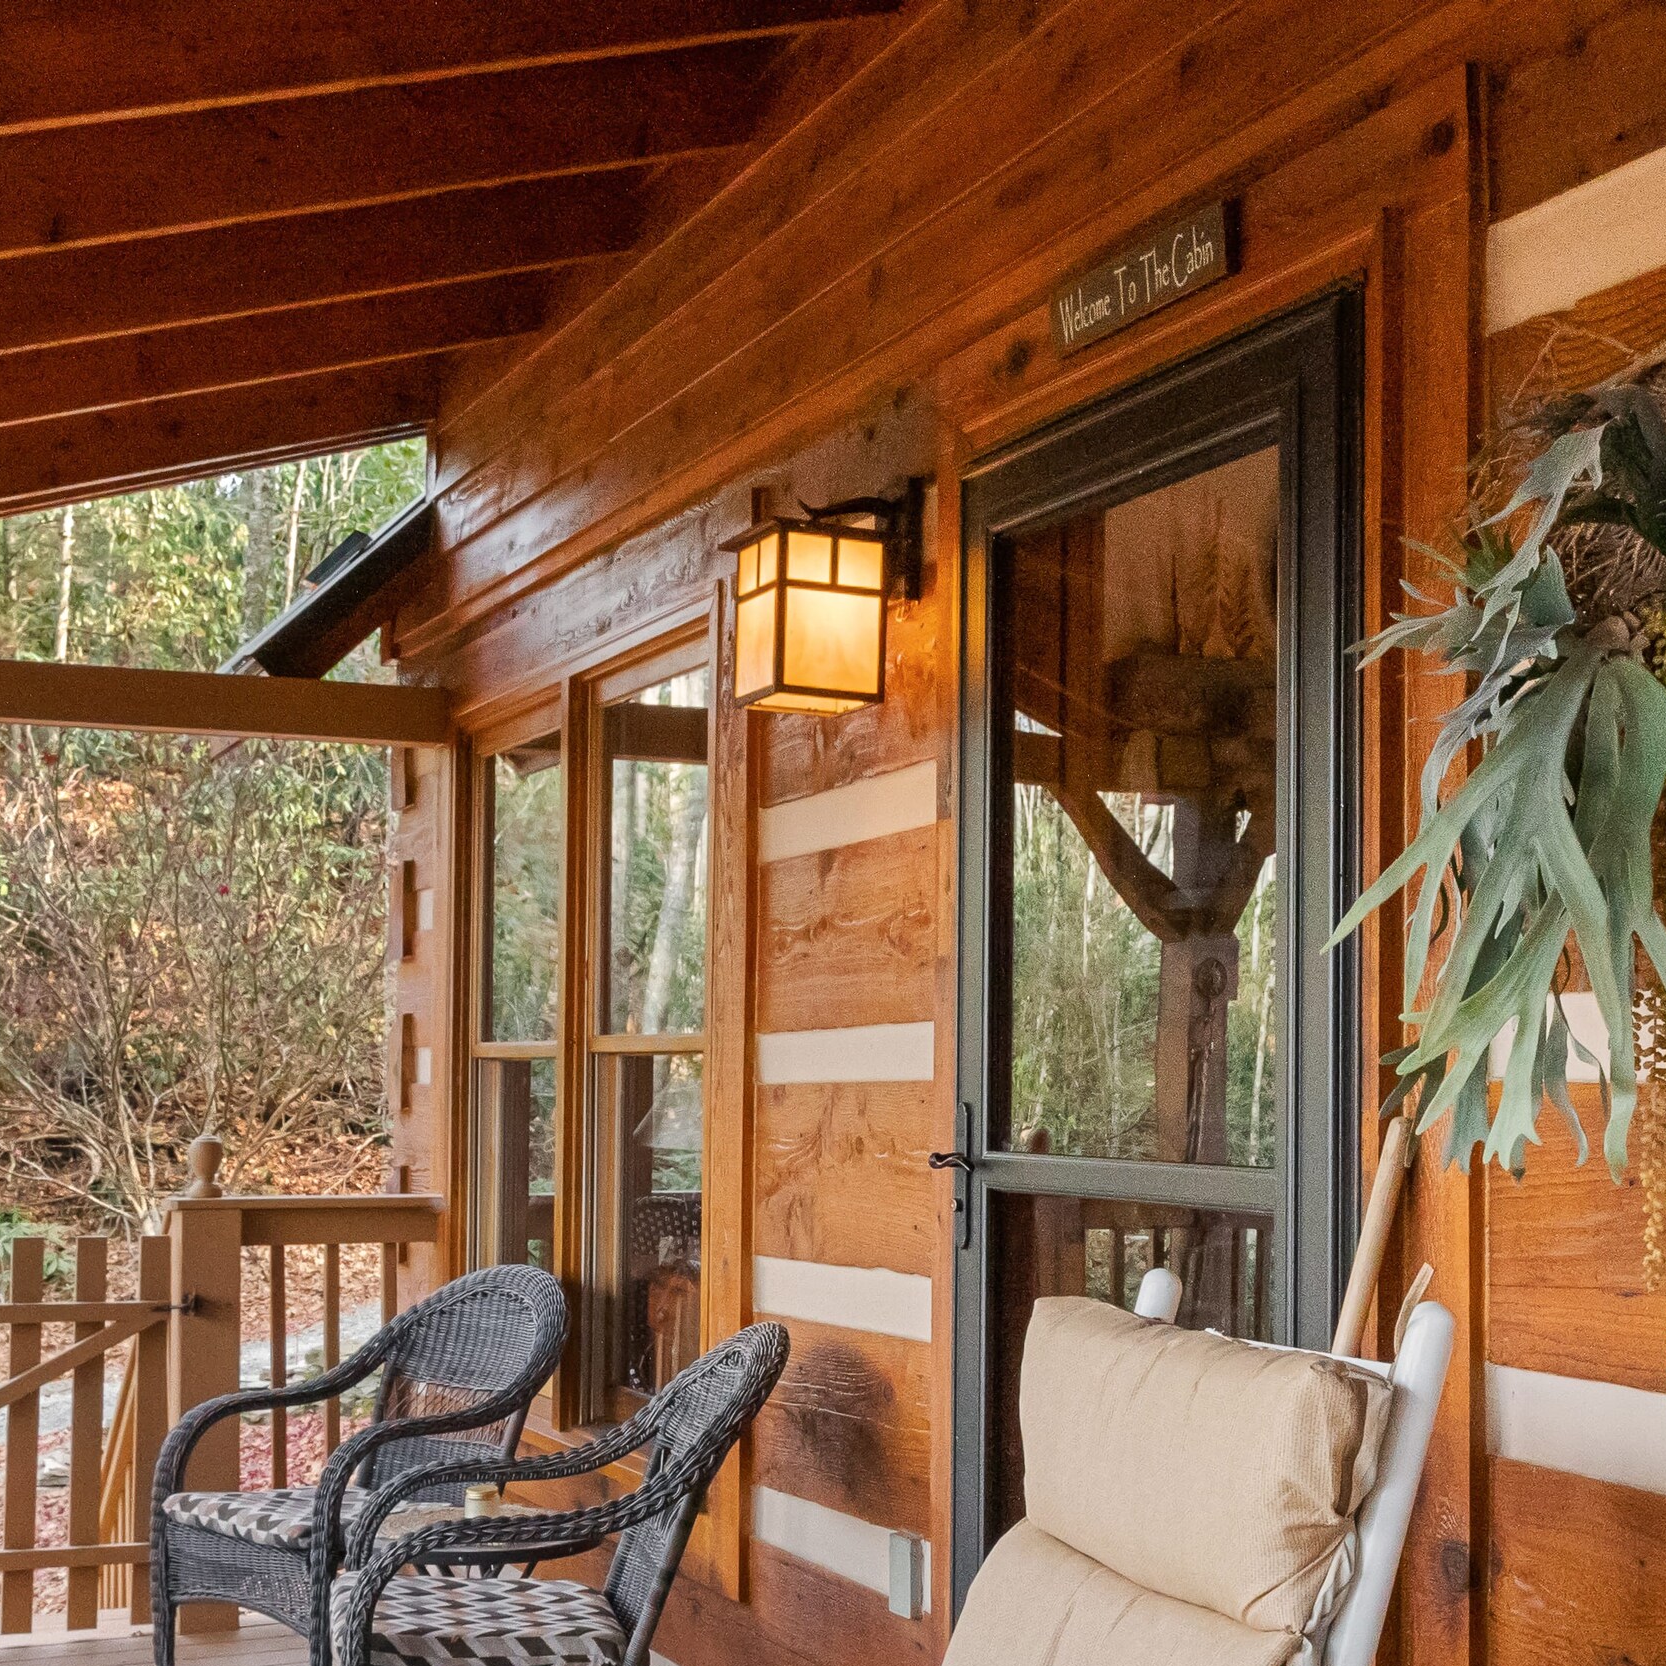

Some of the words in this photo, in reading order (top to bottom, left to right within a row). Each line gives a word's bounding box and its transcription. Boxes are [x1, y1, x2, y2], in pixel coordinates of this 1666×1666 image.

[1059, 287, 1111, 344] Welcome
[1113, 266, 1137, 315] To
[1139, 247, 1170, 303] The
[1171, 226, 1214, 287] Cabin
